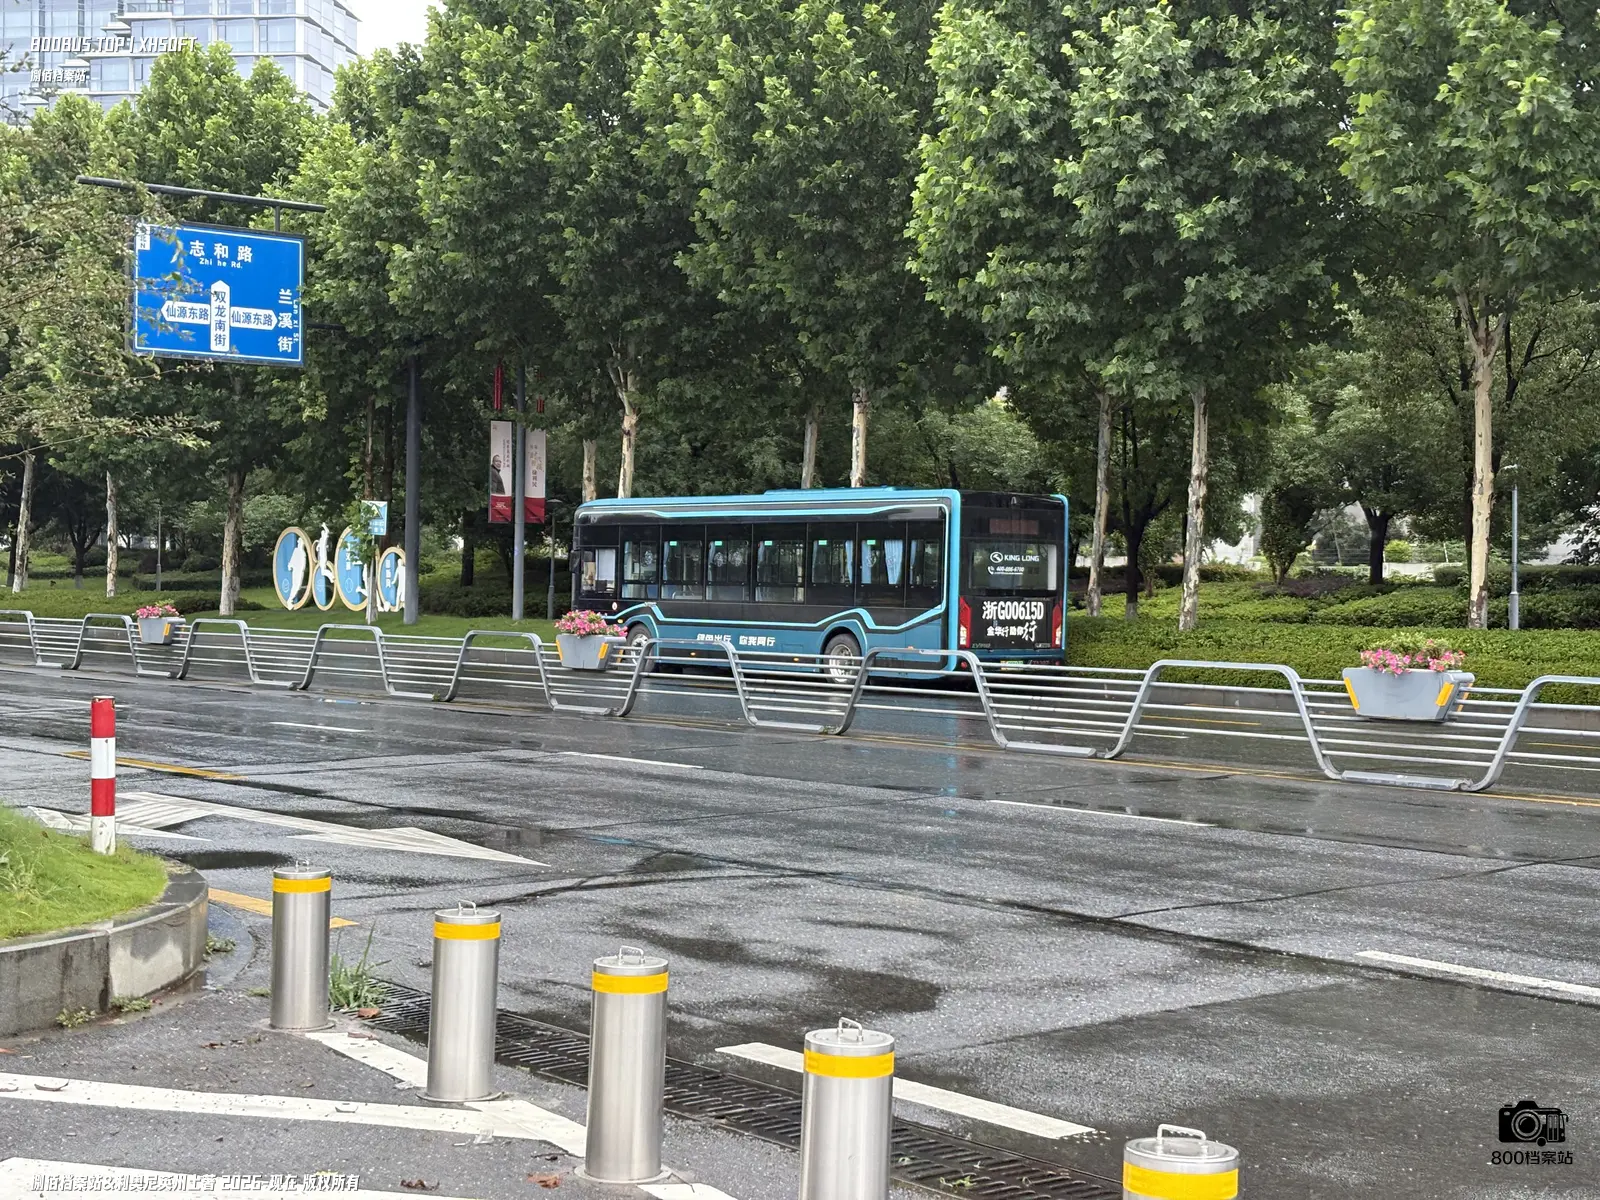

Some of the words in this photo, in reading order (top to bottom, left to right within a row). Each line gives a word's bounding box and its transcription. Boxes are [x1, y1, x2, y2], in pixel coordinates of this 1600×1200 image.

[189, 240, 254, 263] 志和路
[199, 257, 213, 266] Zhi
[217, 259, 227, 267] he
[231, 261, 243, 269] Rd.
[166, 304, 210, 321] 仙源东路
[214, 291, 227, 347] 双龙南街
[231, 310, 273, 327] 仙源东路
[278, 288, 293, 353] 兰溪街
[1004, 554, 1020, 562] KING
[982, 601, 1044, 620] 浙G00615D
